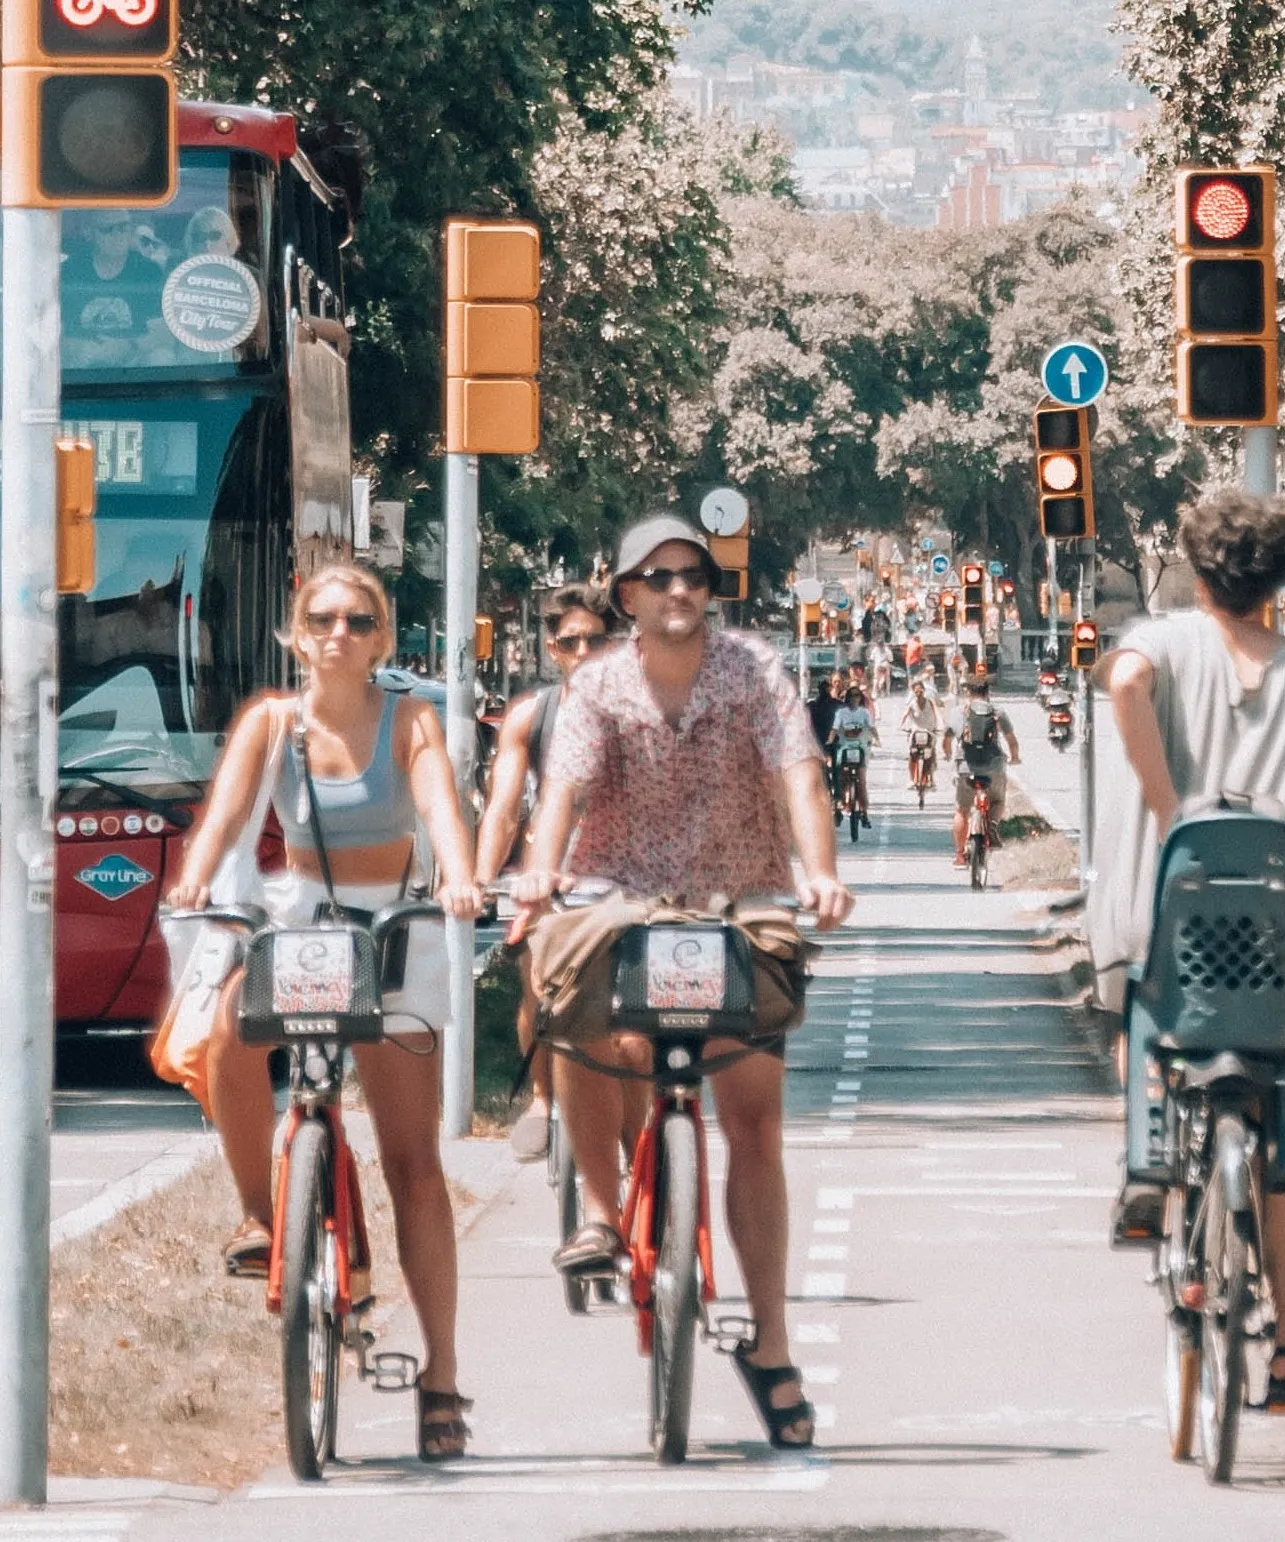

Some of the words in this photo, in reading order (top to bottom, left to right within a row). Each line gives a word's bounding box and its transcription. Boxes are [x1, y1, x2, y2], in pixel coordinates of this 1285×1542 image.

[186, 275, 243, 294] OFFICIAL
[174, 291, 249, 313] BARCELONA
[180, 309, 206, 331] City
[208, 313, 240, 332] Tour
[80, 869, 115, 883] Gray
[117, 869, 147, 884] Line
